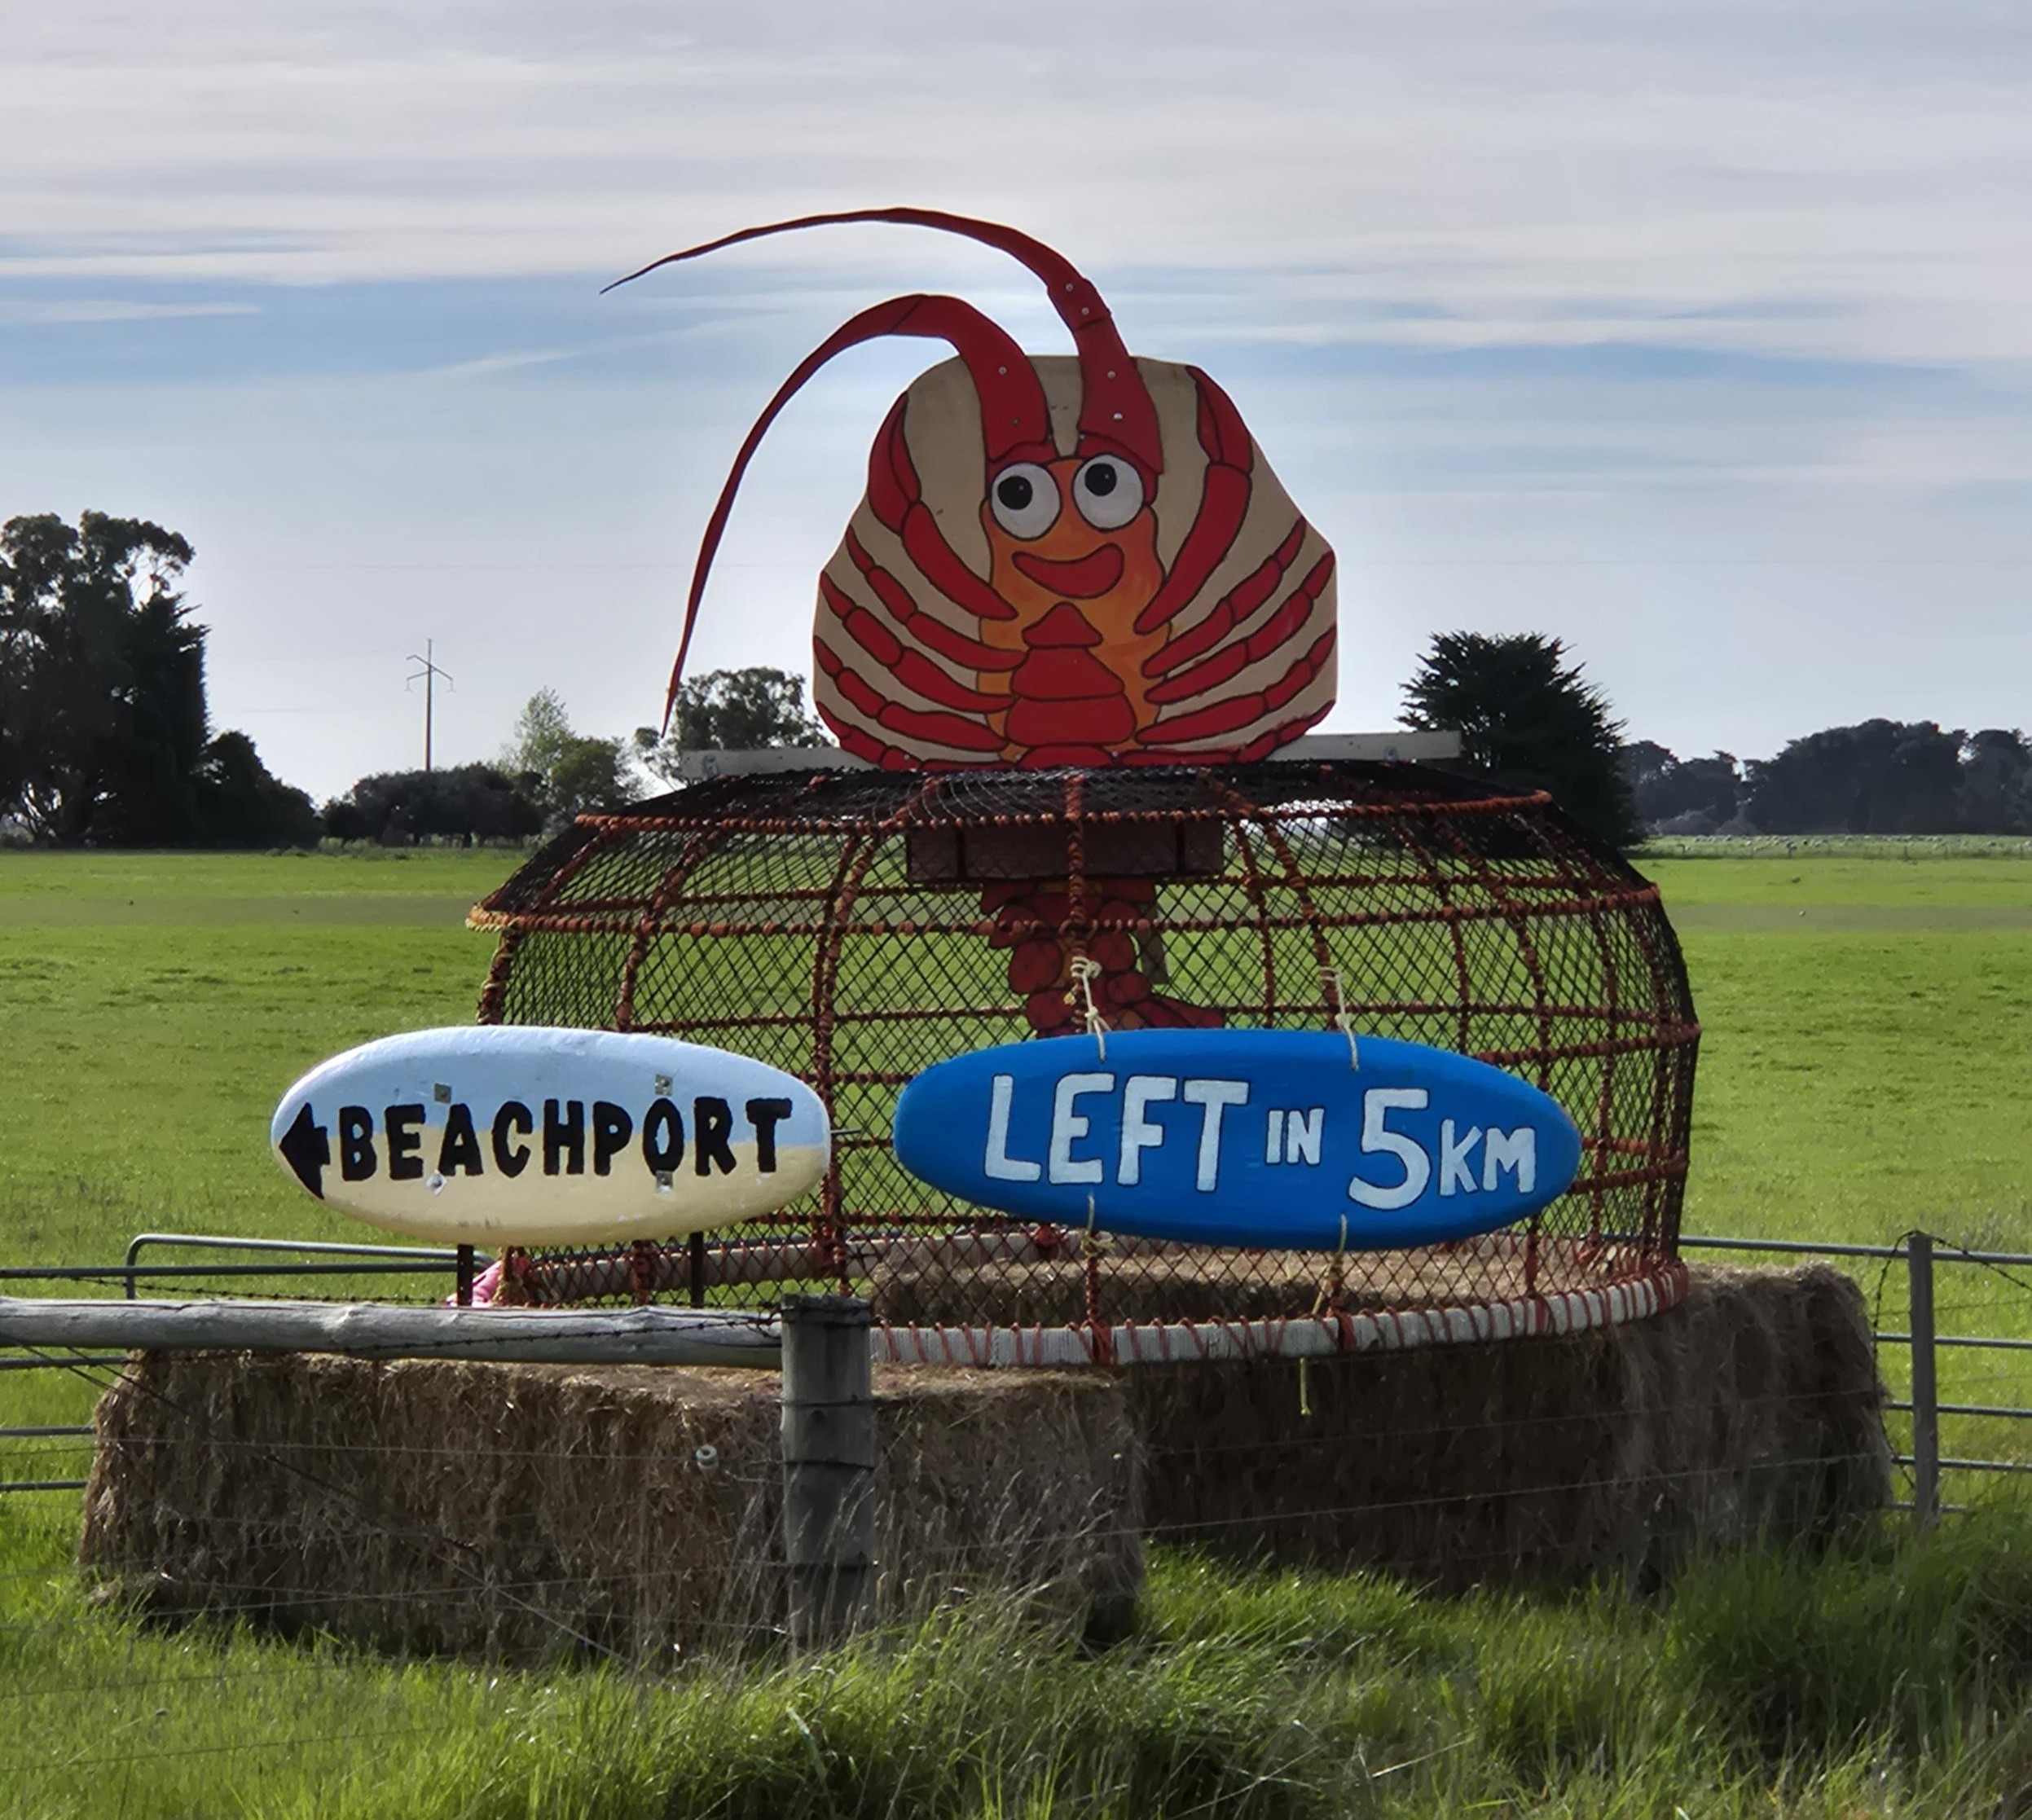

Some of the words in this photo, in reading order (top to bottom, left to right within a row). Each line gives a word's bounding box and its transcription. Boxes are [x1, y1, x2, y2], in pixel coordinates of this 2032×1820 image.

[339, 1097, 792, 1180] BEACHPORT
[984, 1073, 1249, 1191] LEFT
[1266, 1107, 1324, 1164] IN
